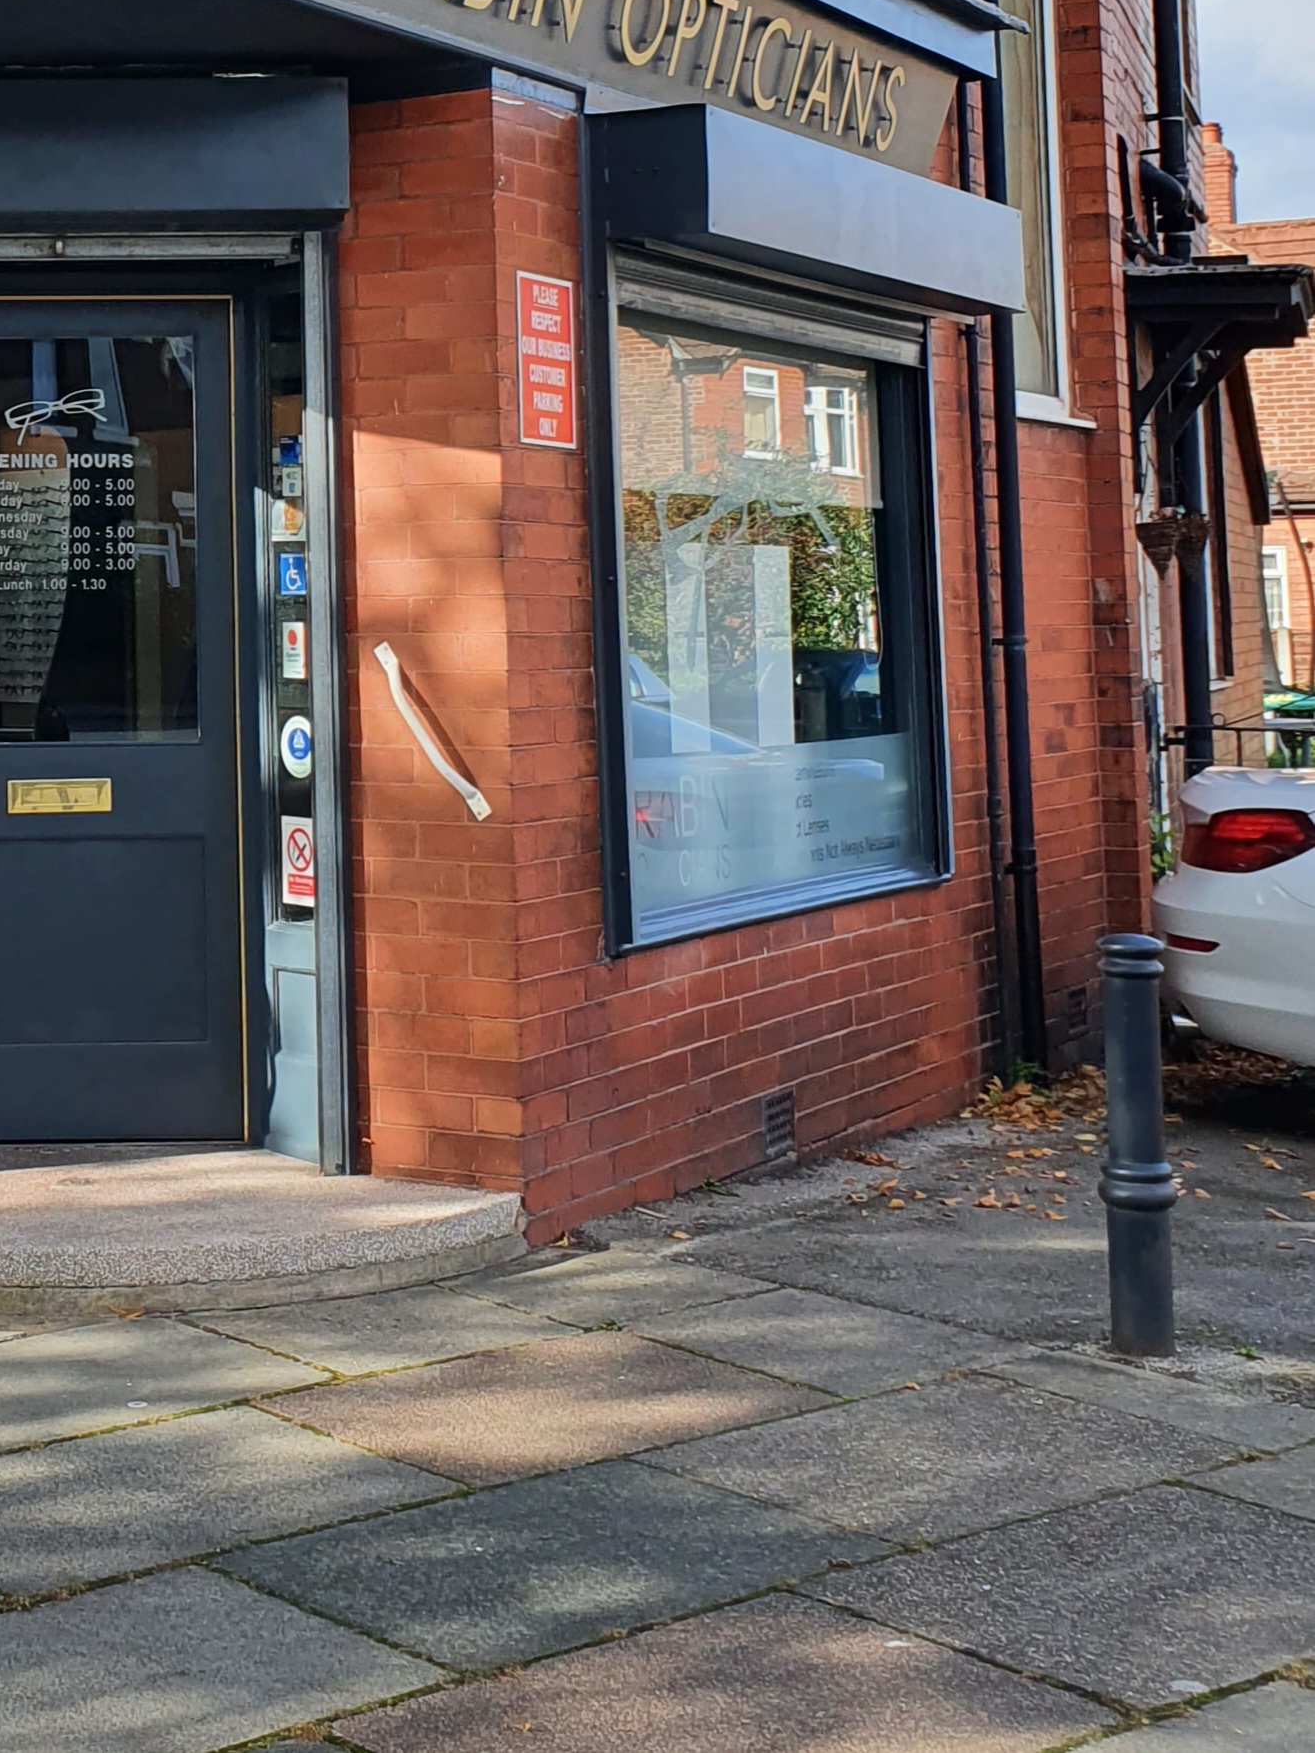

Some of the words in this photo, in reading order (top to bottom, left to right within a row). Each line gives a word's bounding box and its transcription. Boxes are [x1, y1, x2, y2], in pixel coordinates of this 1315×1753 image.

[532, 284, 559, 308] PLEASE
[530, 310, 562, 333] RESPECT
[521, 335, 536, 355] OUR
[538, 338, 572, 362] BUSINESS
[529, 363, 566, 388] CUSTOMER
[532, 390, 564, 414] PARKING
[66, 453, 134, 468] HOURS
[105, 478, 135, 491] 5.00
[105, 494, 135, 507] 5.00
[59, 526, 90, 538] 9.00
[105, 526, 135, 538] 5.00
[59, 542, 90, 555] 9.00
[105, 542, 135, 555] 5.00
[59, 558, 90, 571] 9.00
[105, 558, 135, 571] 3.00
[42, 578, 67, 591] 1.00
[81, 578, 107, 591] 1.30
